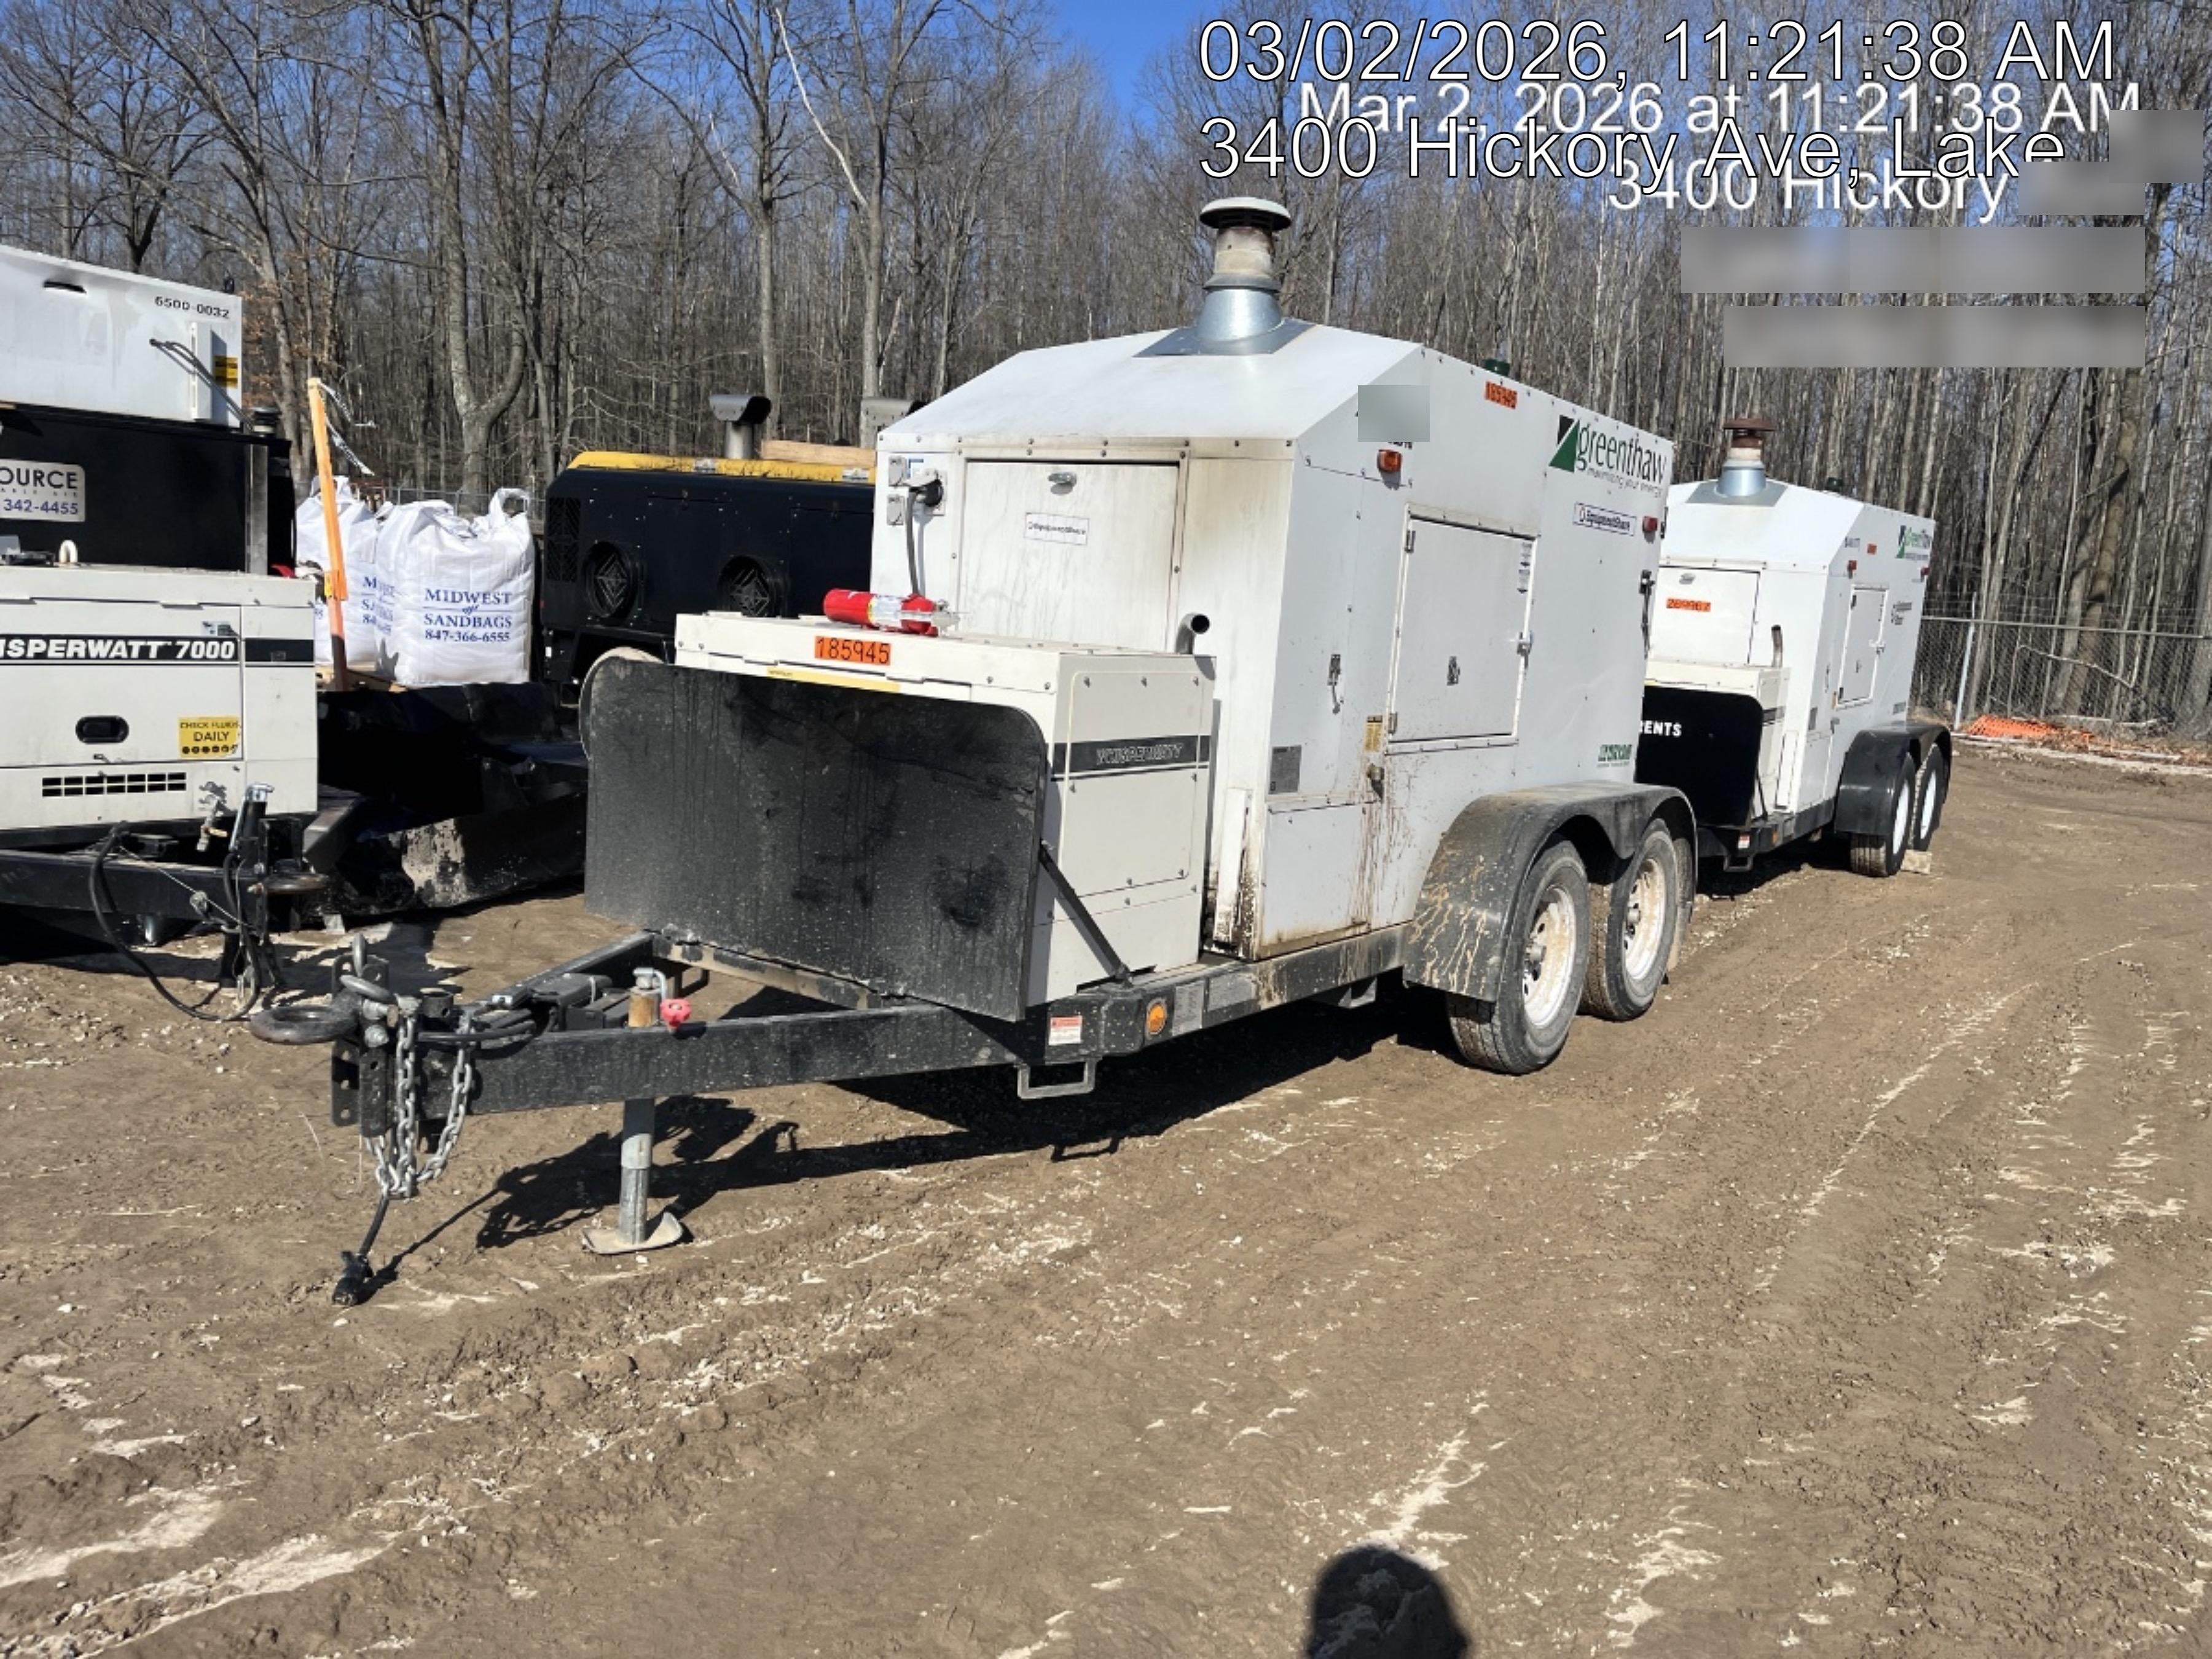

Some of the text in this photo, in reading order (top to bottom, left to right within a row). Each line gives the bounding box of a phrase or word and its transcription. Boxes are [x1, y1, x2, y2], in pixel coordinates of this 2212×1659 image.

[3, 498, 78, 515] 342-4455
[424, 588, 512, 605] MIDWEST
[423, 613, 512, 628] SANDBAGS
[425, 629, 511, 643] 847-366-6555
[176, 641, 235, 659] 7000
[817, 638, 890, 664] 185945
[193, 731, 230, 742] DAILY
